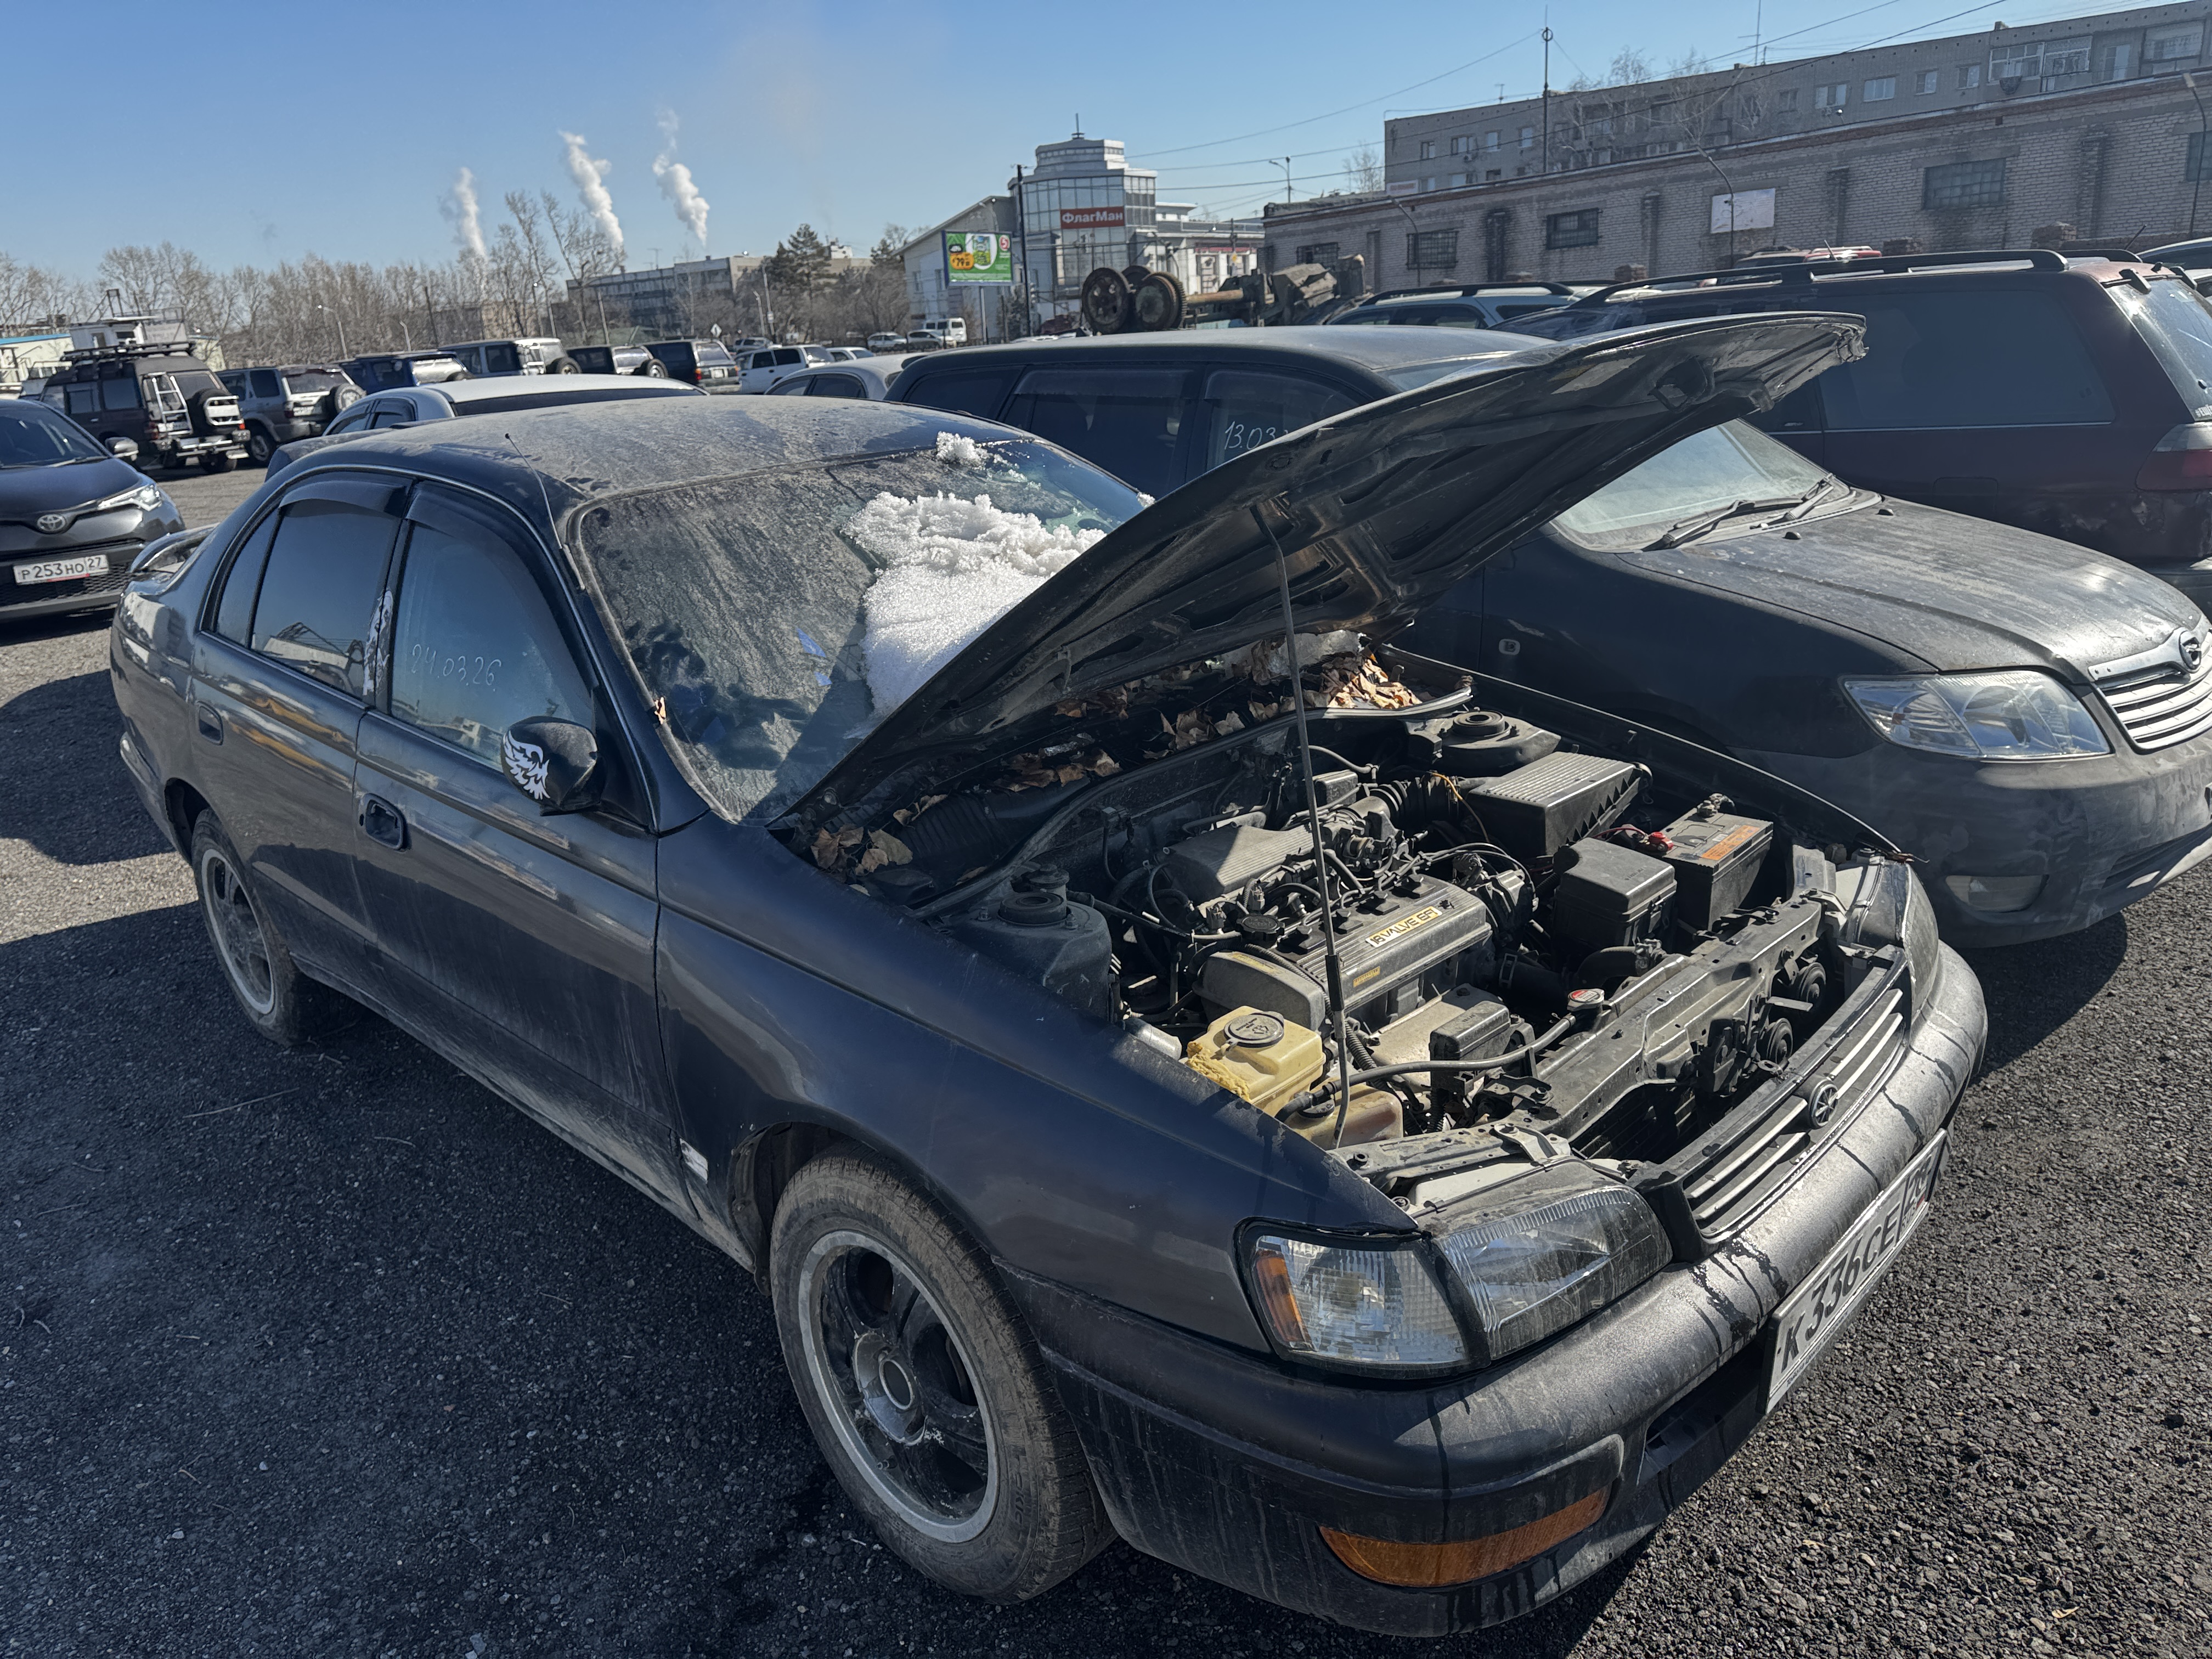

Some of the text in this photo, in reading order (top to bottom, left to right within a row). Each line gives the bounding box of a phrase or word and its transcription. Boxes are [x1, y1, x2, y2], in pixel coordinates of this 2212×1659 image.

[1062, 211, 1123, 223] ФлагМан
[87, 557, 101, 568] 27
[1383, 918, 1419, 938] VALVE
[1417, 909, 1438, 921] EFI
